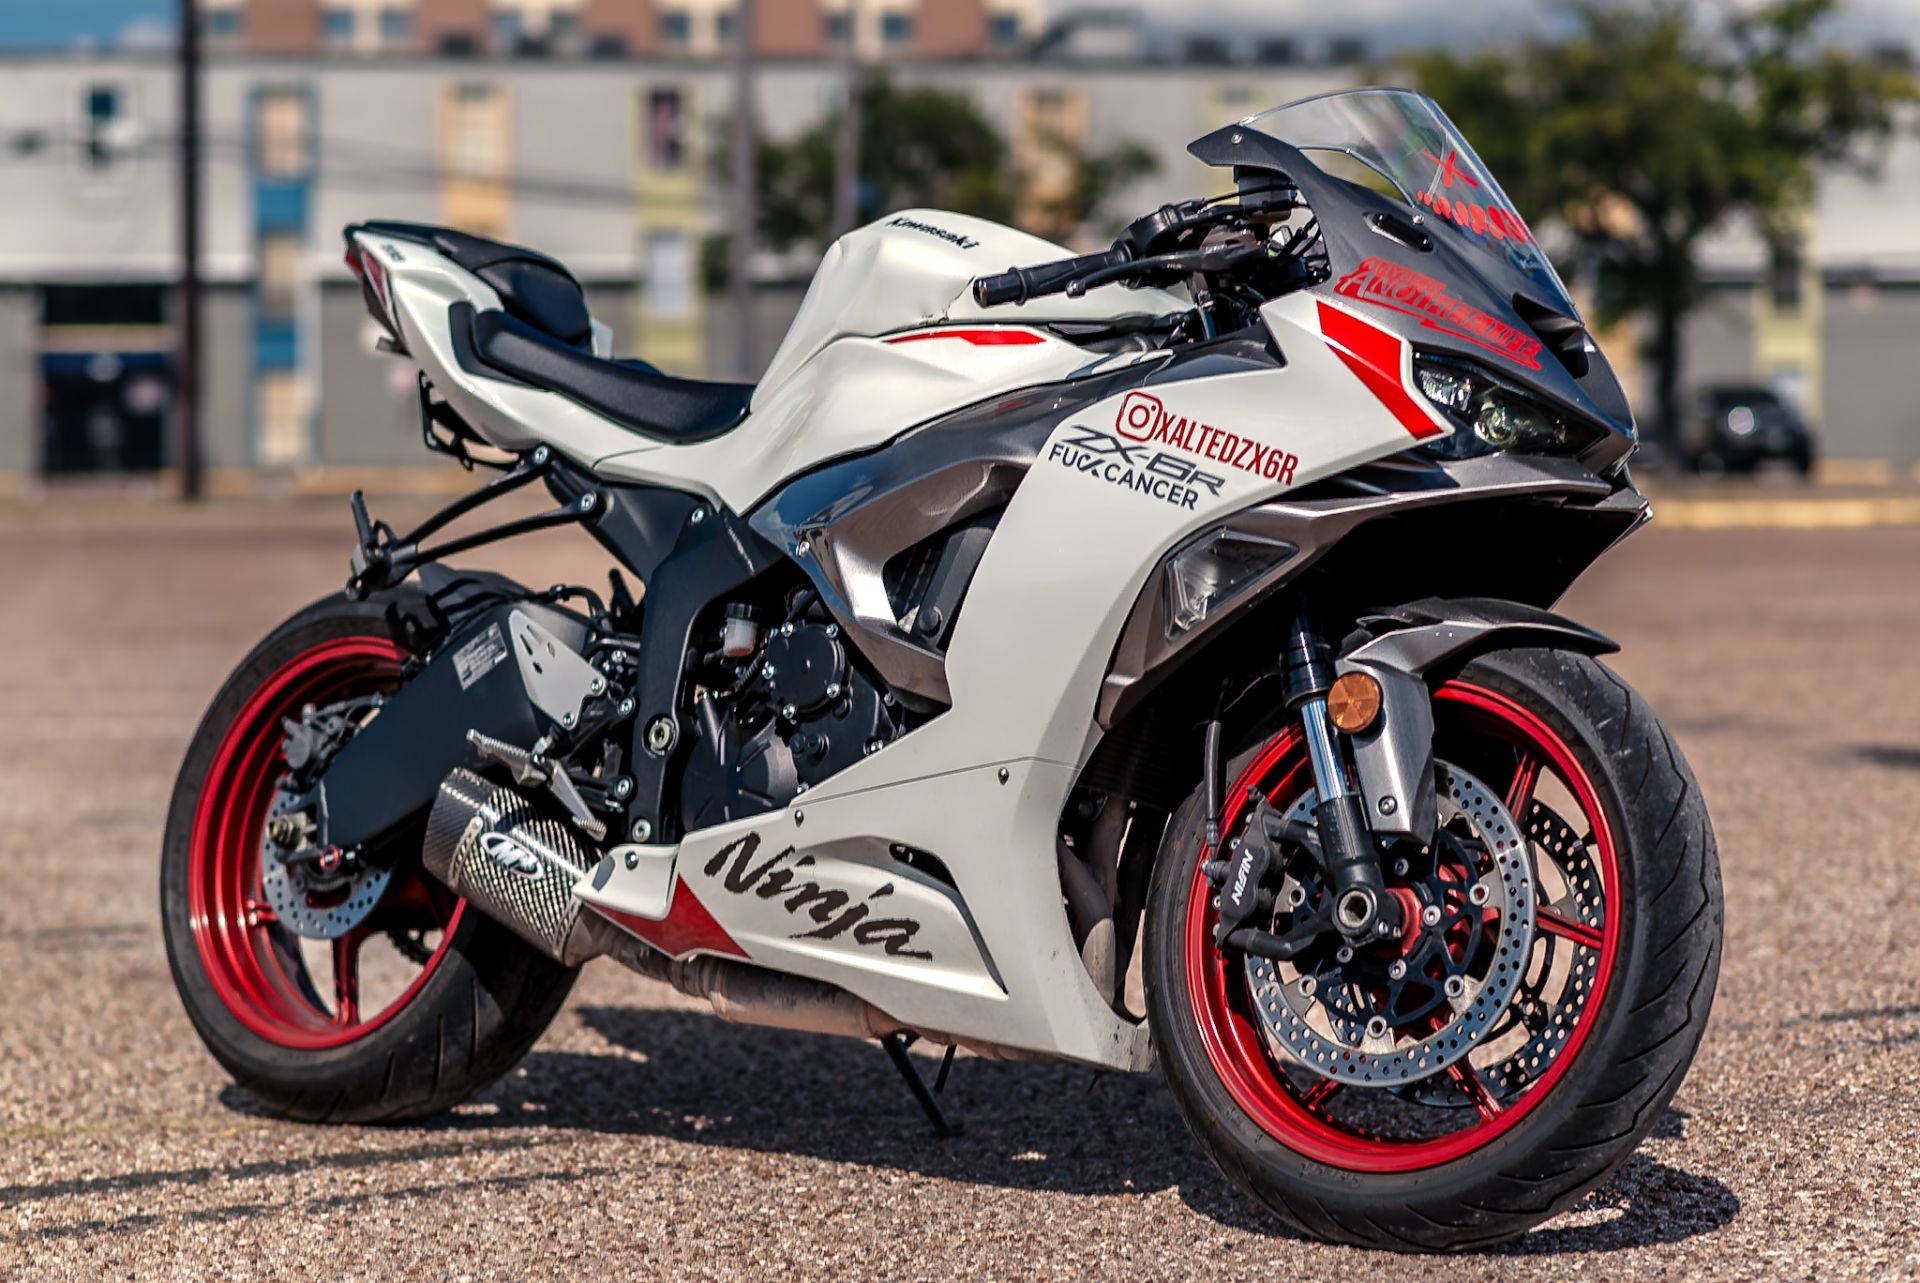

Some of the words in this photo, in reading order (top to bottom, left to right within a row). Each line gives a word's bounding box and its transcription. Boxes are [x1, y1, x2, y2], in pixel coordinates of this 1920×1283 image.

[1060, 424, 1226, 497] ZX-6R
[1153, 411, 1299, 487] XALTEDZX6R
[1104, 463, 1199, 511] CANCER
[704, 831, 933, 961] Ninja
